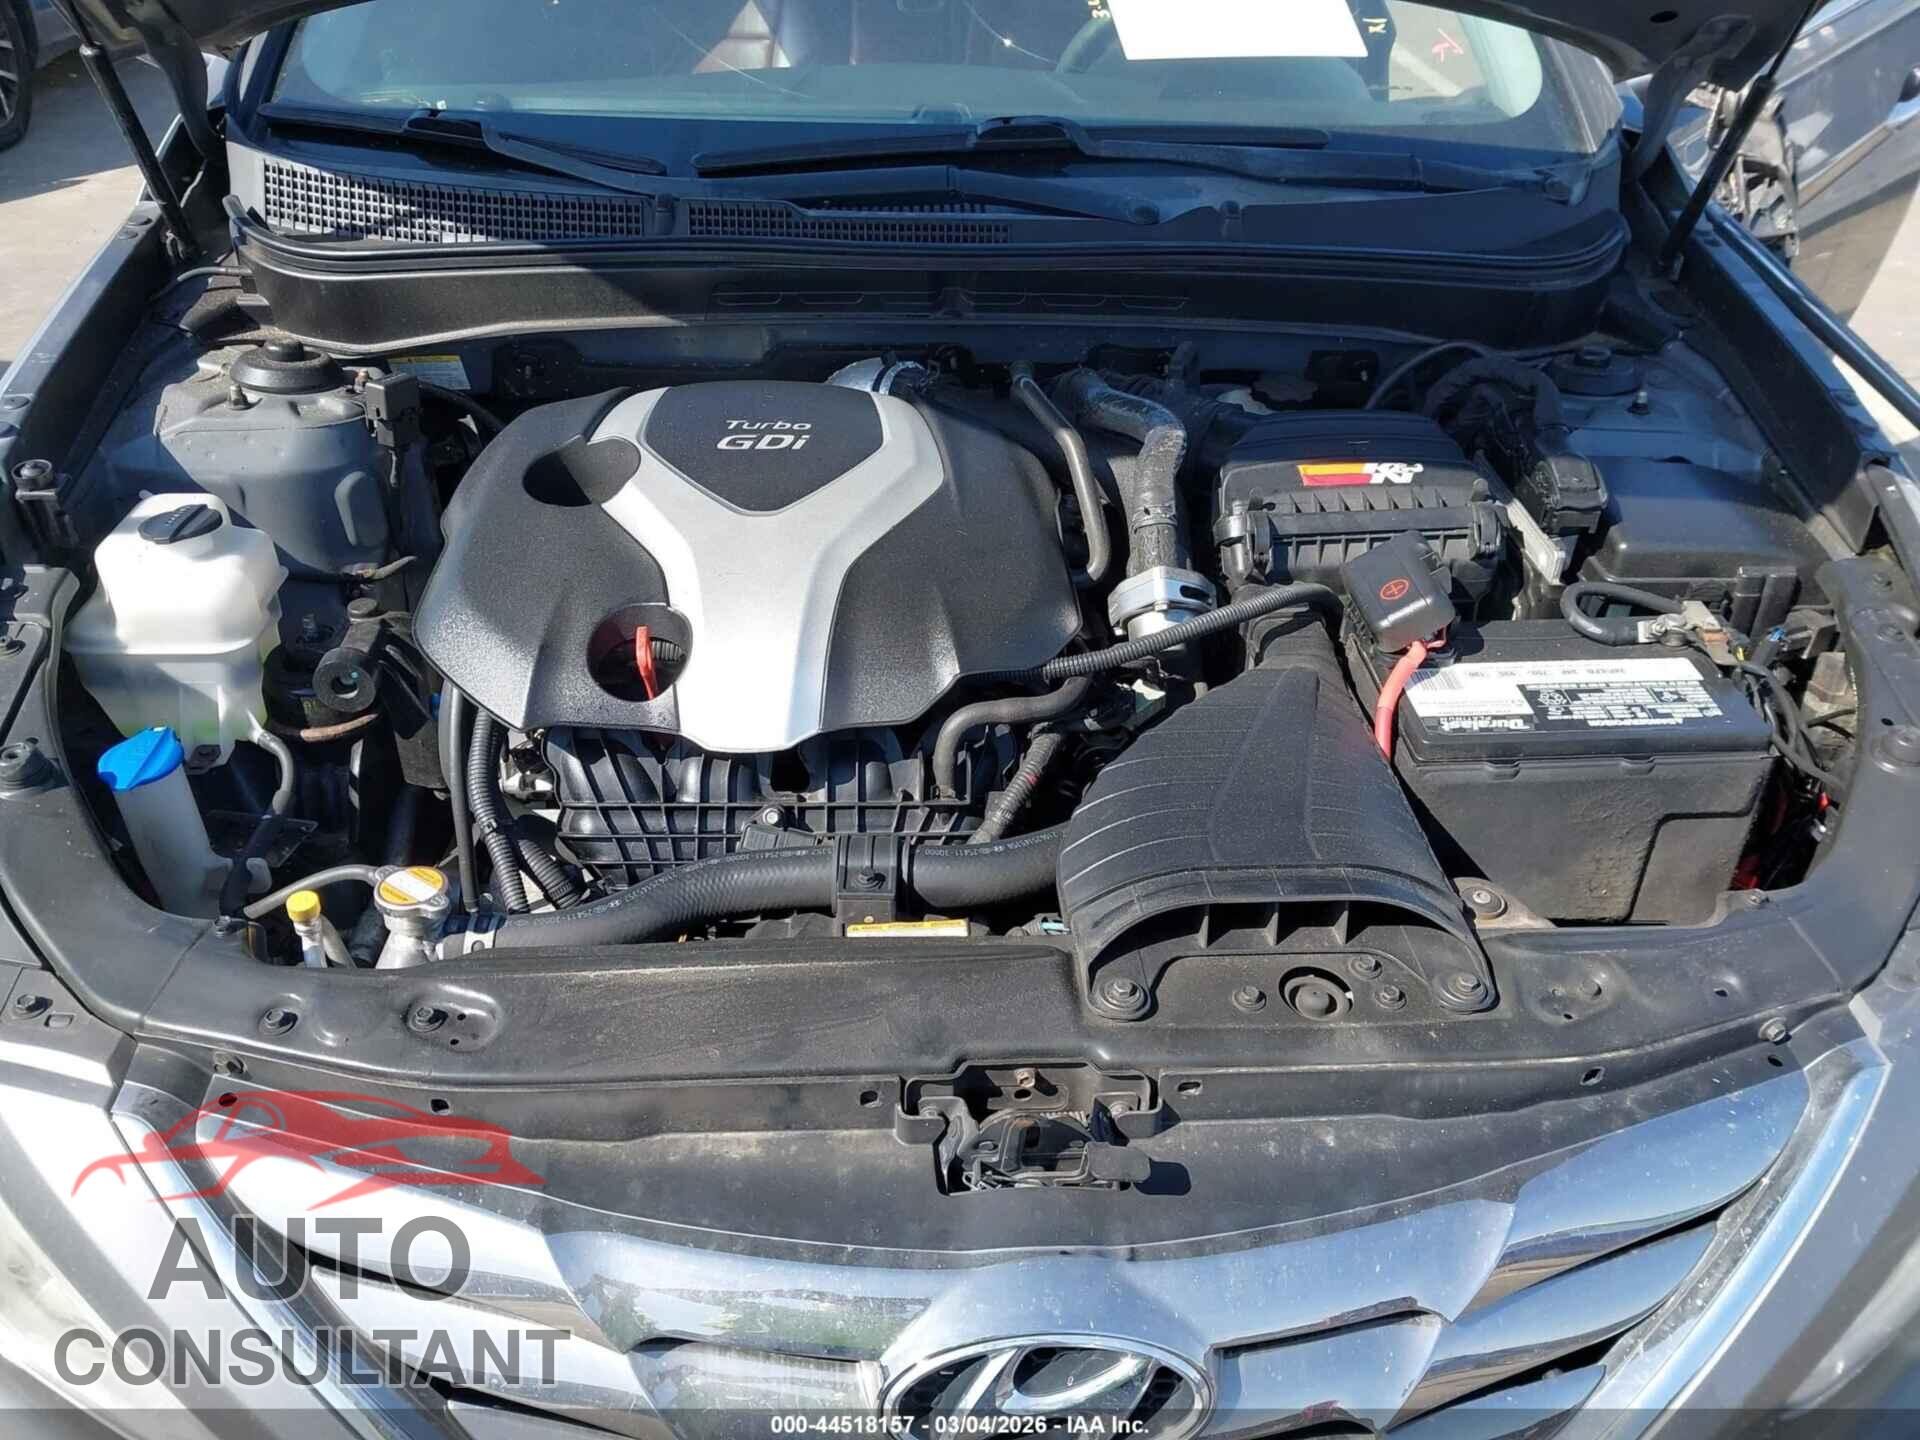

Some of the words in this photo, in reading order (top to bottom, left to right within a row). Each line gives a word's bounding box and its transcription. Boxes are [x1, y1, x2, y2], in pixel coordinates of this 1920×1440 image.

[726, 420, 812, 430] Turbo
[717, 435, 810, 449] GDi
[1440, 717, 1530, 731] Duralast
